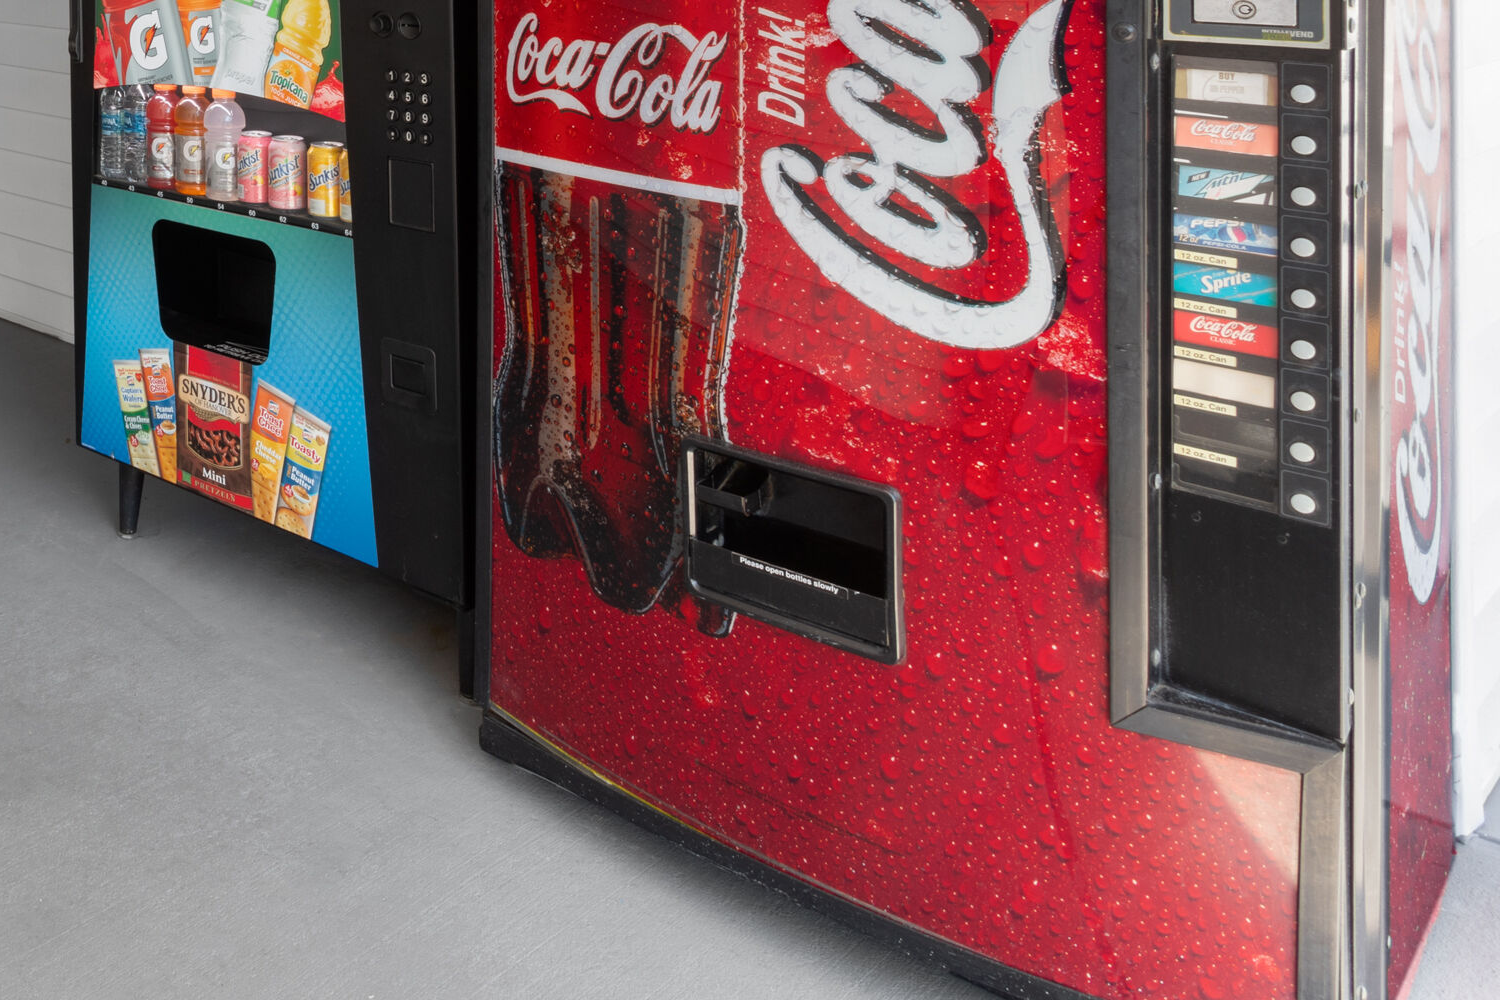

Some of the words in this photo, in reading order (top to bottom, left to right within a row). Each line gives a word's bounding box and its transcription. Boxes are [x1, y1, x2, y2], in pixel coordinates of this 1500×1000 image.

[130, 10, 168, 70] G
[190, 15, 215, 54] G
[506, 11, 728, 136] Coca-Cola
[757, 5, 807, 127] Drink!
[1218, 72, 1235, 80] BUY
[269, 69, 308, 104] Tropicana
[388, 70, 394, 80] 1
[404, 72, 410, 82] 2
[421, 73, 427, 84] 3
[388, 90, 395, 100] 4
[405, 92, 411, 102] 5
[422, 94, 428, 104] 6
[389, 110, 395, 120] 7
[405, 112, 411, 122] 8
[422, 113, 428, 124] 9
[406, 131, 412, 141] 0
[1191, 120, 1258, 142] Coca-Cola
[183, 140, 203, 162] G
[216, 147, 236, 169] G
[238, 150, 261, 172] nkist
[309, 162, 339, 192] Sunkis
[1191, 173, 1206, 182] NEW
[249, 209, 256, 217] 60
[311, 222, 319, 230] 63
[1190, 219, 1245, 229] PEPSI
[1202, 240, 1247, 251] PEPSI-COLA
[1209, 256, 1227, 265] Can
[1200, 272, 1252, 294] Sprite
[1209, 305, 1227, 314] Can
[1190, 315, 1258, 342] Coca-Cola
[1394, 262, 1409, 404] Drink!
[1209, 354, 1227, 363] Can
[182, 378, 245, 414] SNYDER'S
[155, 405, 173, 413] Peanut
[259, 406, 284, 428] Toast
[1209, 403, 1227, 413] Can
[290, 435, 322, 464] Toasty
[1181, 447, 1191, 455] 12
[1209, 453, 1227, 463] Can
[202, 466, 227, 486] Mini
[290, 473, 311, 491] Butter
[291, 465, 315, 485] Peanut
[194, 479, 236, 502] PRETZELS
[739, 556, 764, 570] Please
[765, 565, 784, 577] open
[785, 571, 812, 586] bottles
[813, 580, 839, 595] slowly
